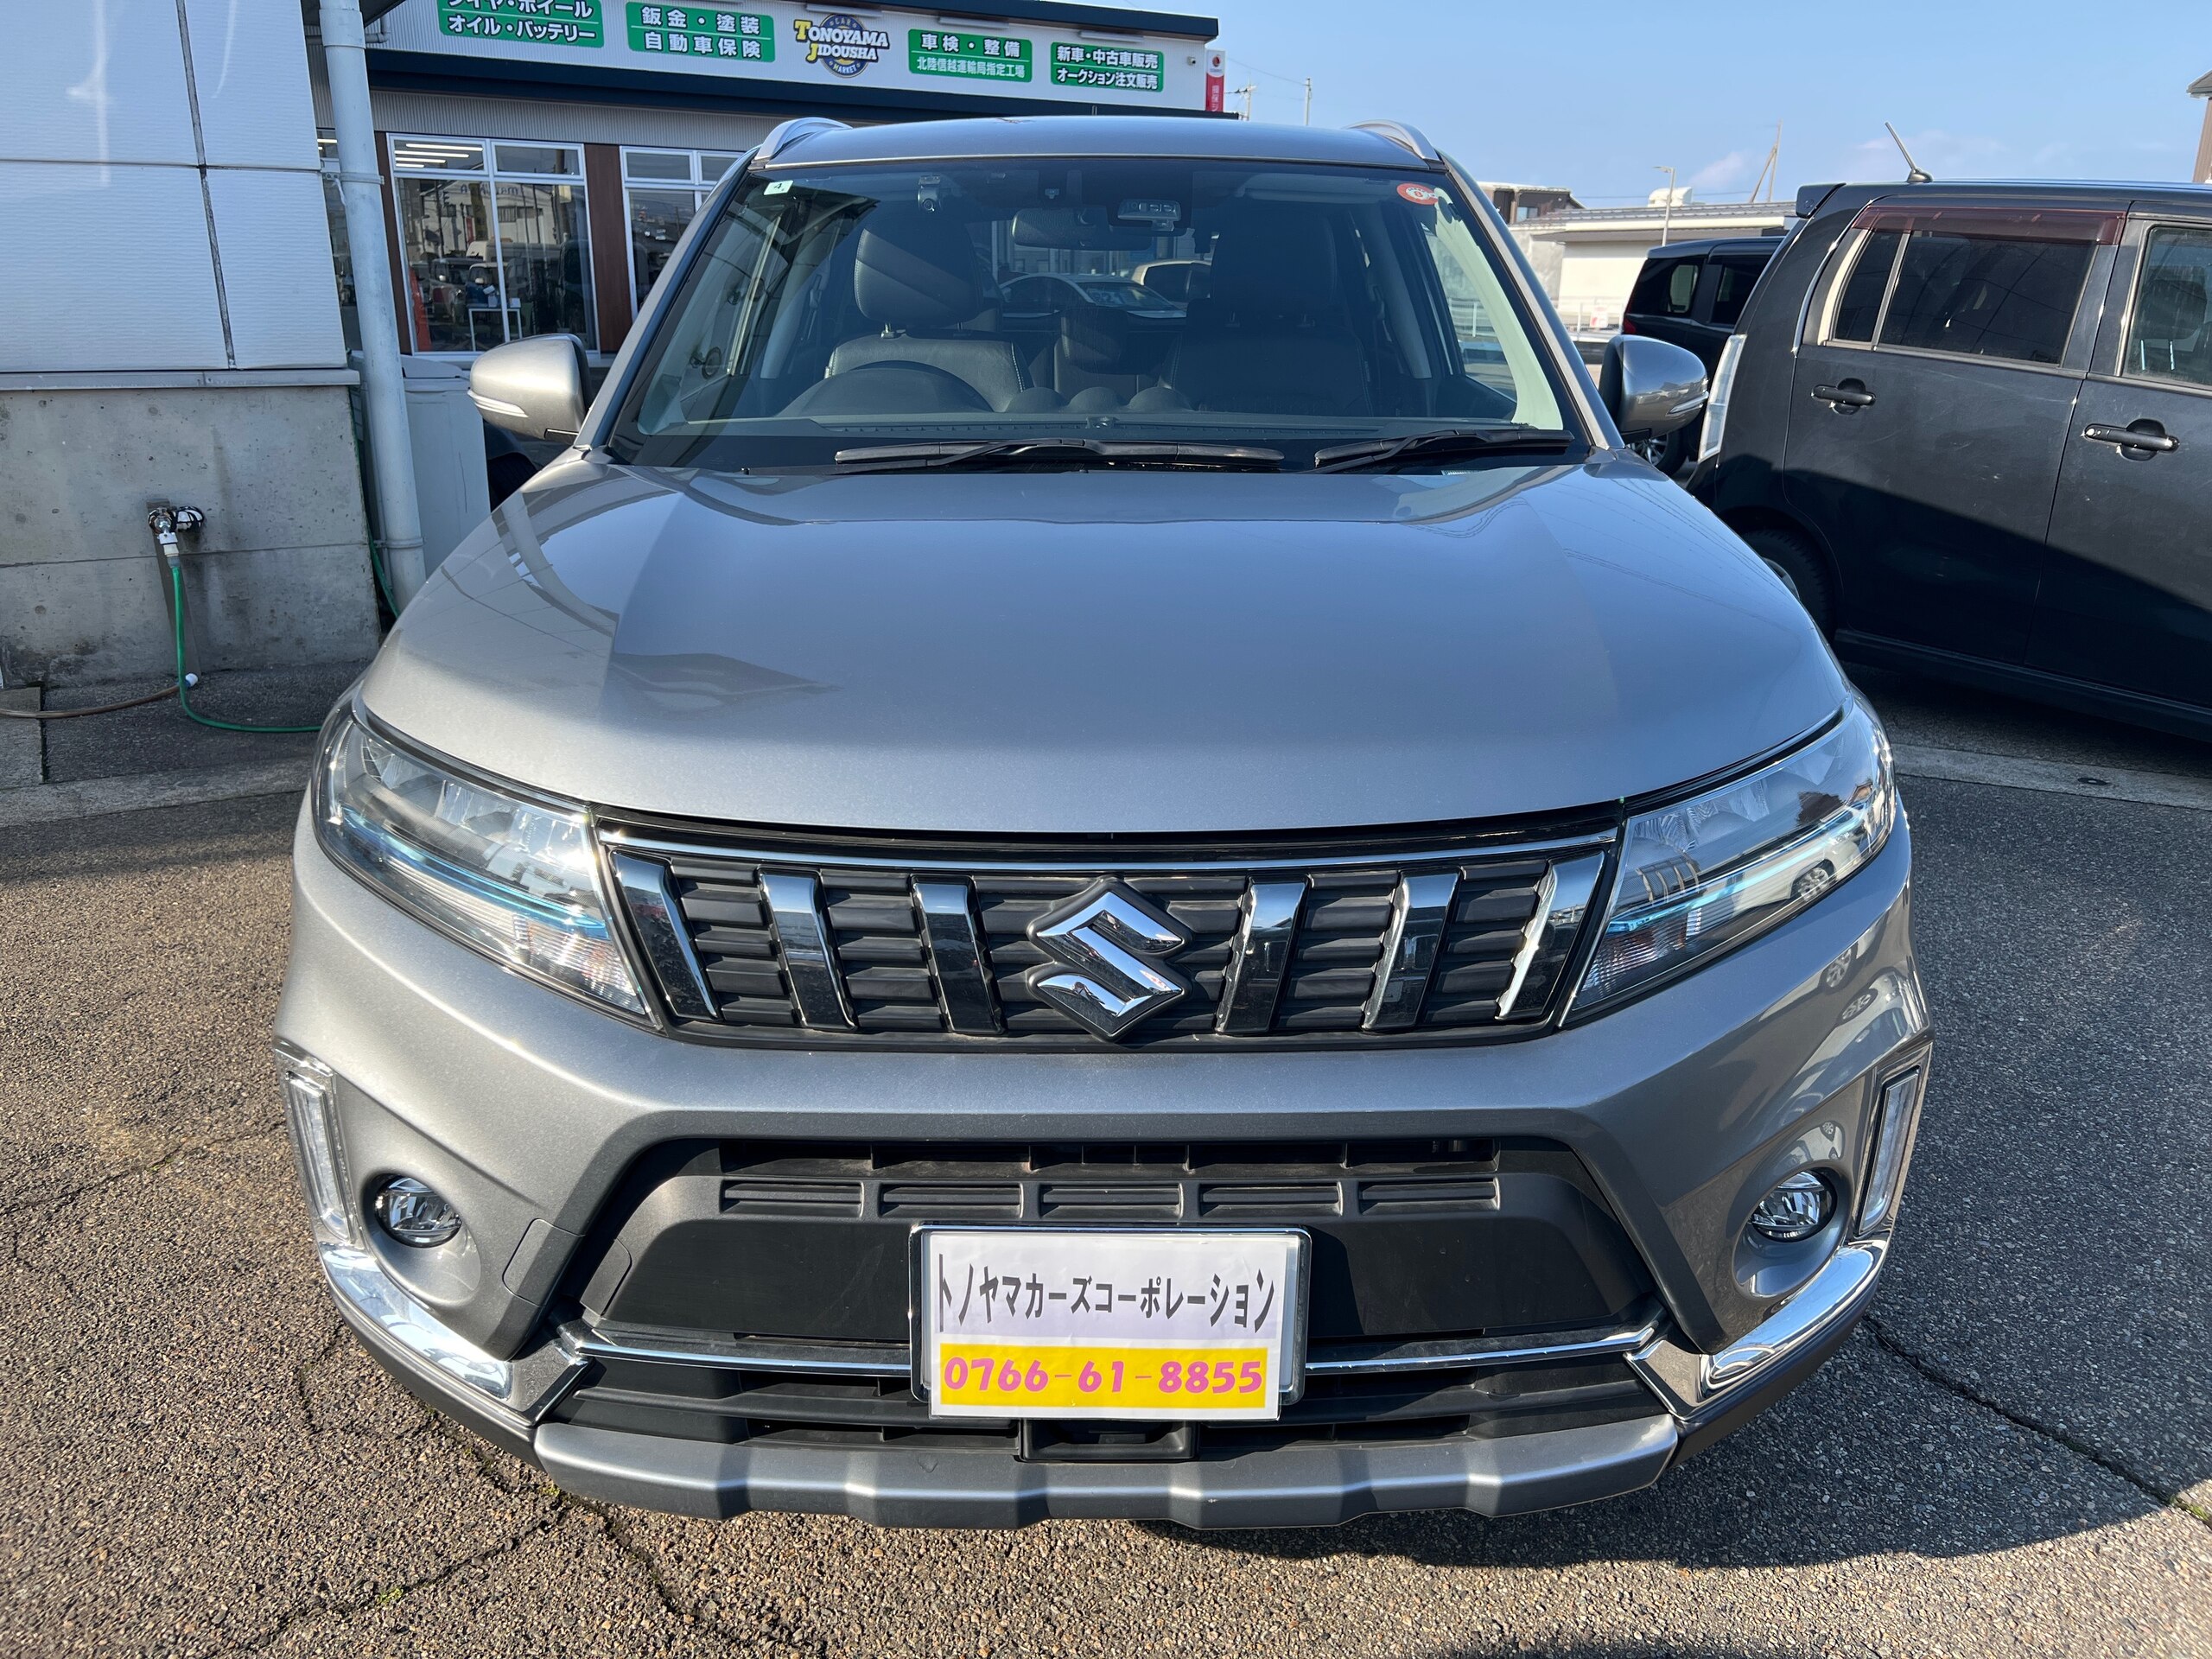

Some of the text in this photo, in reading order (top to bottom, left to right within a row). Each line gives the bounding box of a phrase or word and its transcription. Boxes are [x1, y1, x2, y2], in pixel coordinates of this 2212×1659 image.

[448, 15, 595, 41] オイル・バッテリー
[641, 6, 760, 35] 鈑金・塗装
[644, 31, 761, 58] 自動車保険
[794, 20, 889, 47] TONOYAMA
[921, 34, 1020, 58] 車検・整備
[806, 42, 878, 61] JIDOUSHA
[1057, 46, 1159, 69] 新車・中古車販売
[832, 64, 857, 74] MARKET
[917, 56, 1026, 79] 北陸信越運輸局指定工場
[1057, 67, 1158, 90] オークション注文販売
[938, 1253, 1274, 1334] トノヤマカーズコーポレーション
[944, 1357, 1263, 1395] 0766-61-8855
